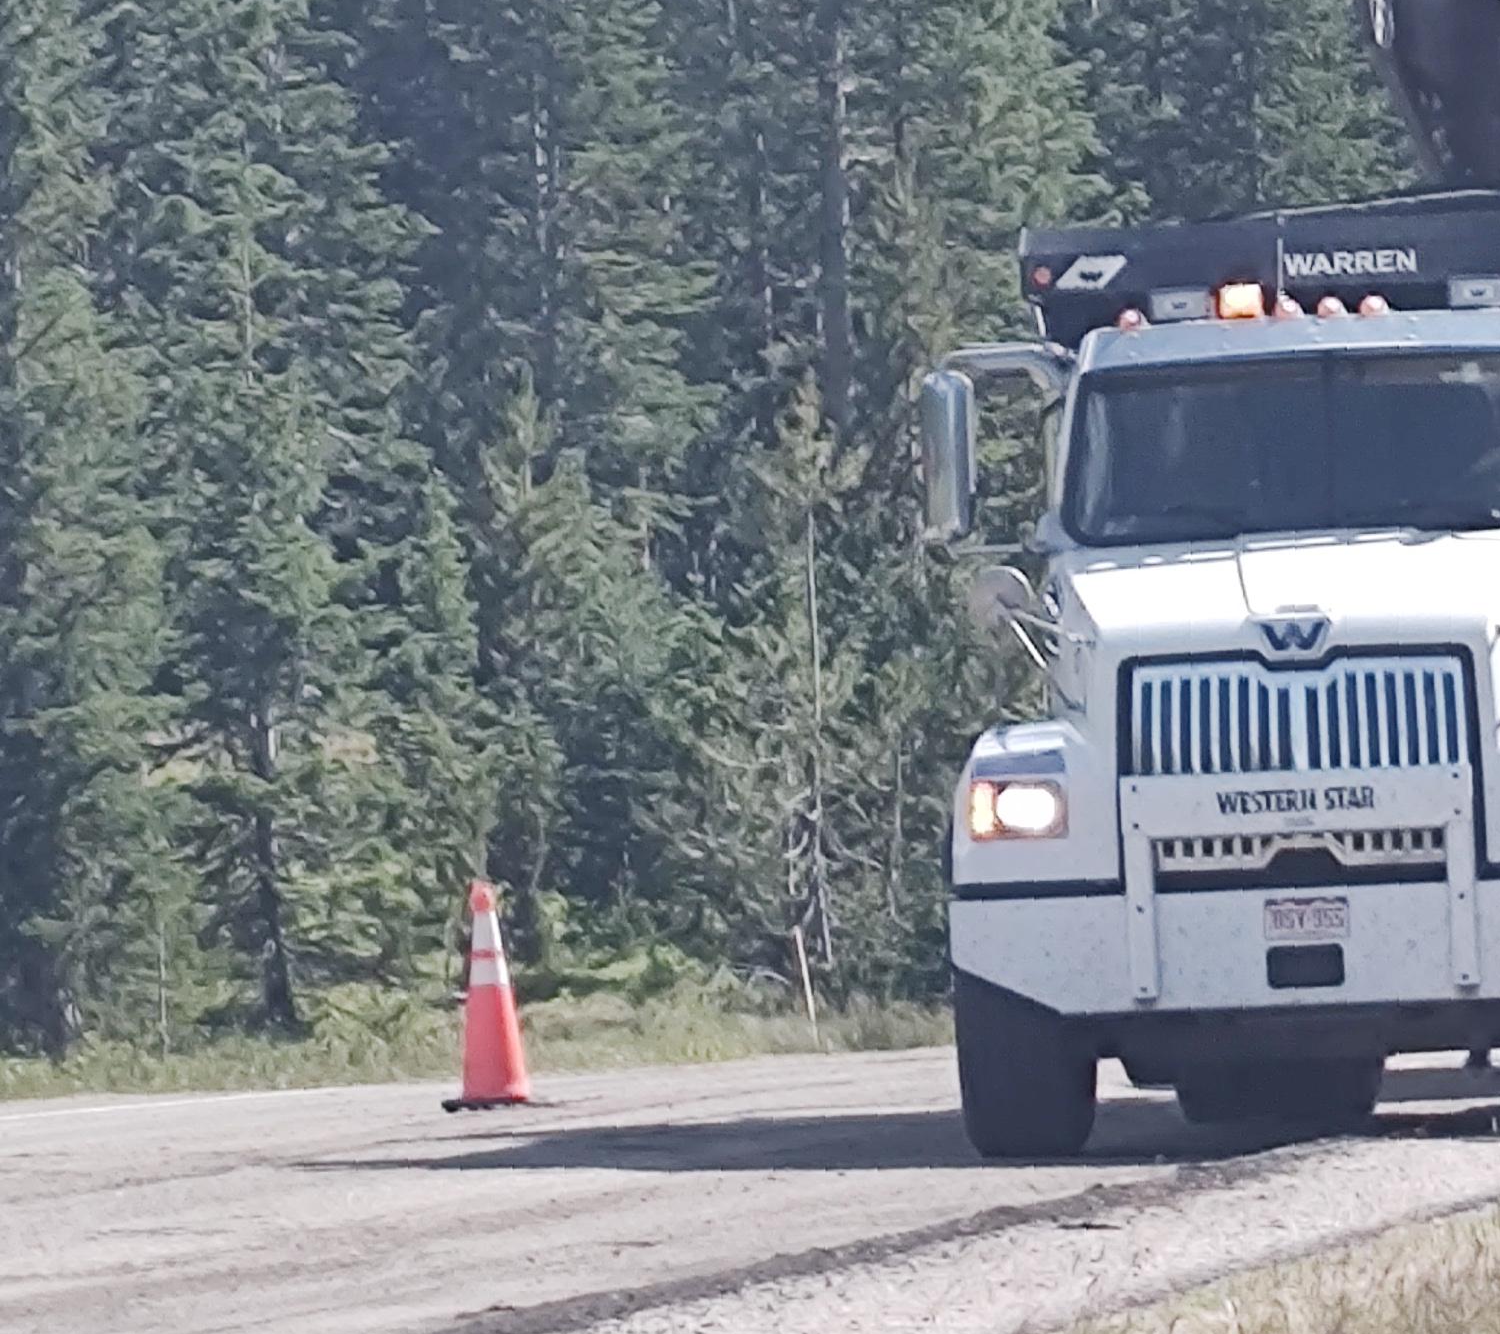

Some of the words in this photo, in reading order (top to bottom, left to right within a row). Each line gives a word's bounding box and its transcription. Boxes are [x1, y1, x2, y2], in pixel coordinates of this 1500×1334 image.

[1284, 248, 1417, 277] WARREN
[1216, 789, 1317, 815] WESTERN
[1324, 785, 1374, 810] STAR
